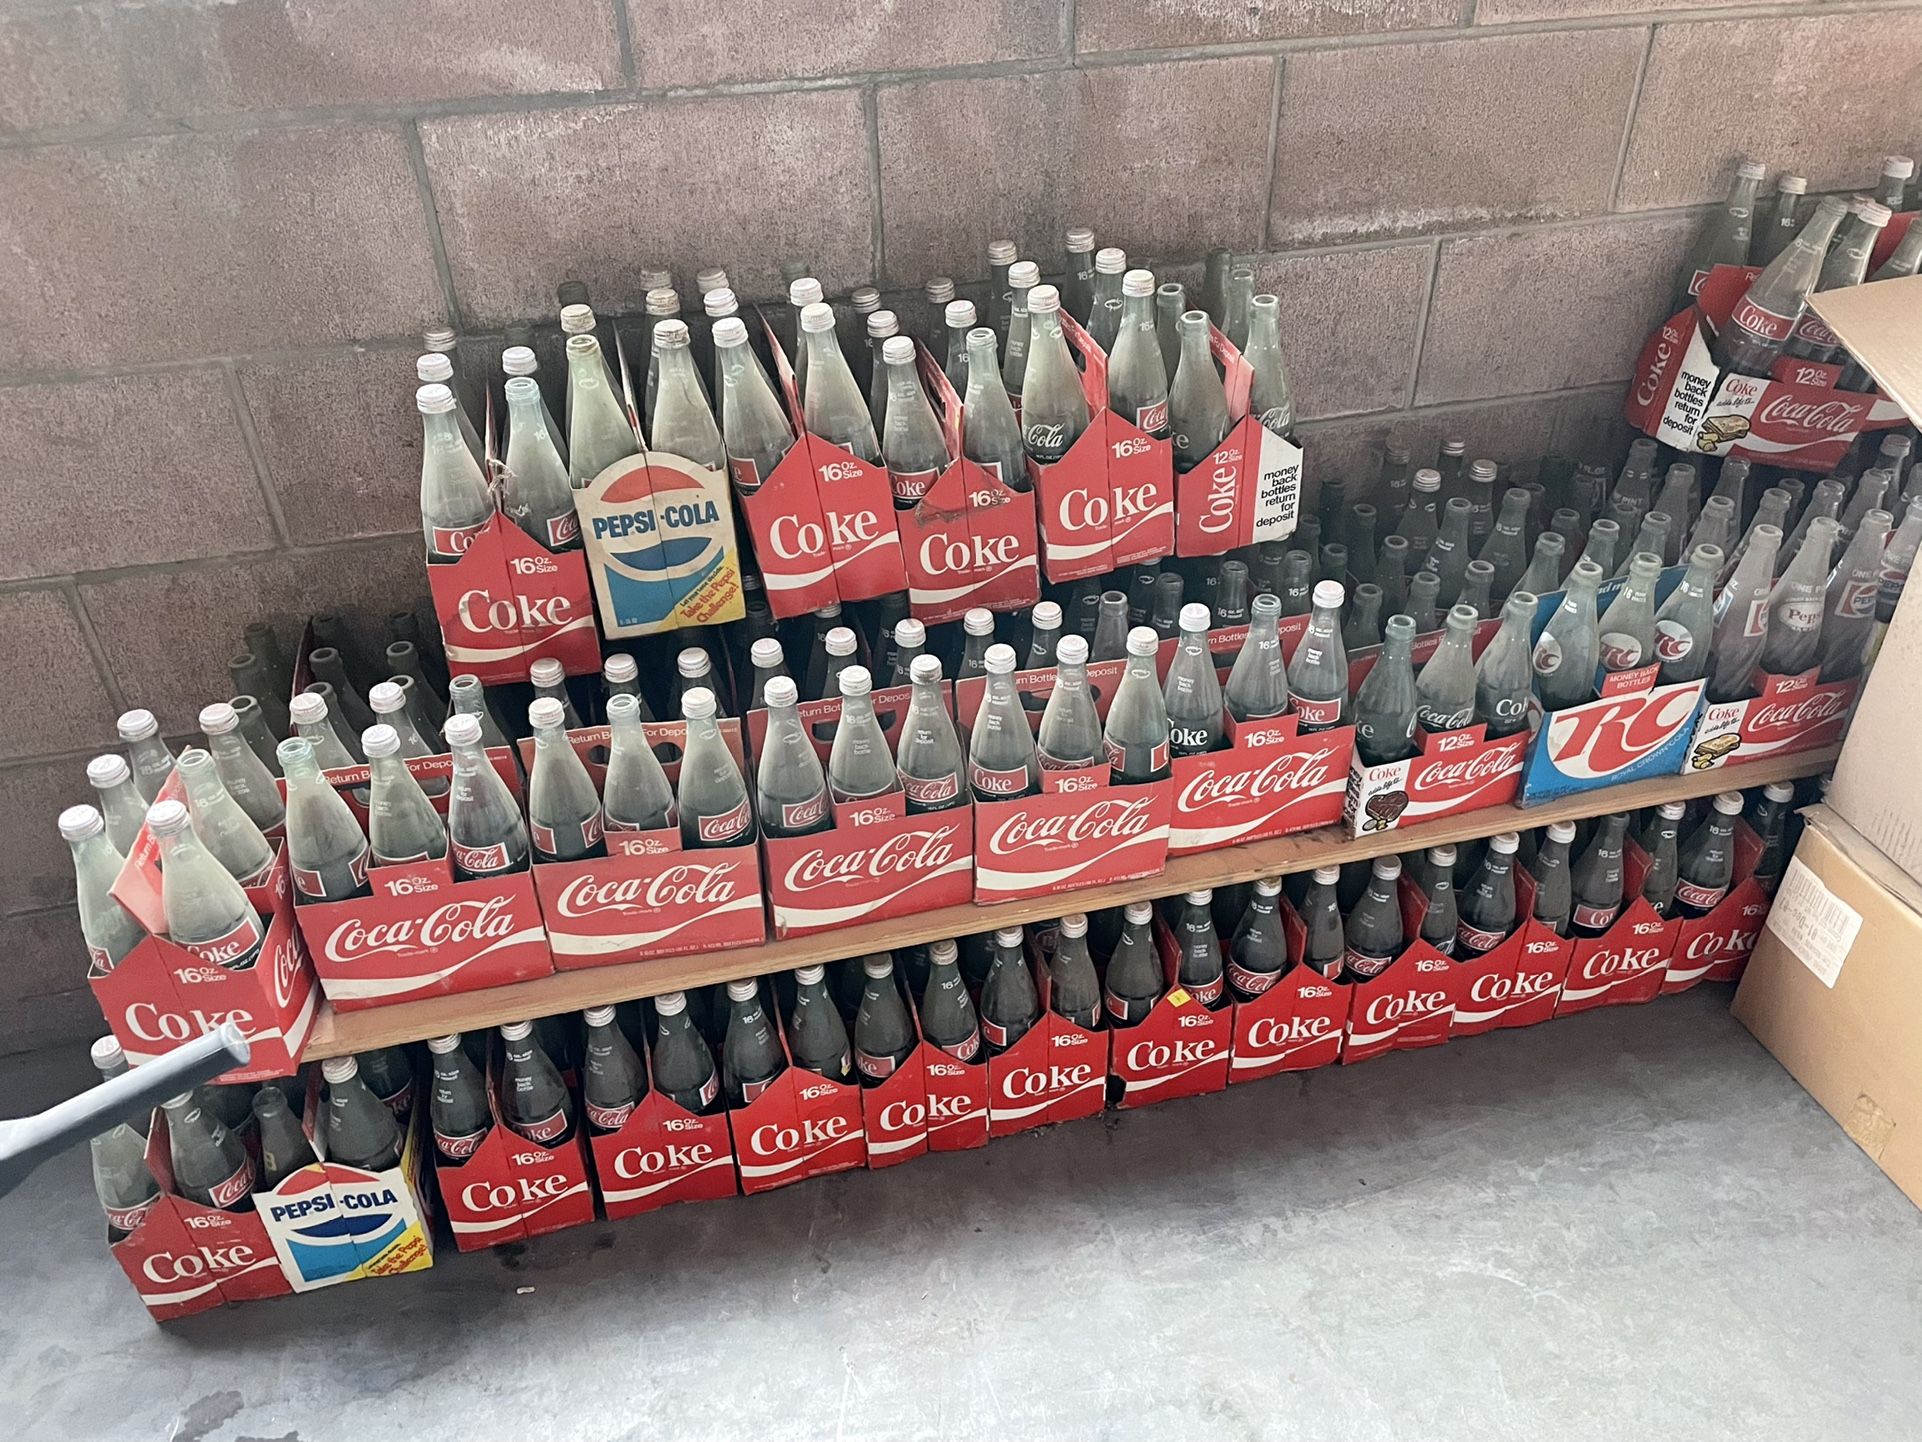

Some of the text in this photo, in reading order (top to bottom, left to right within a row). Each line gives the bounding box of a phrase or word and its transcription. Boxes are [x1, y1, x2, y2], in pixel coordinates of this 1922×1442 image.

[1078, 271, 1088, 280] 16
[1739, 305, 1778, 336] Coke
[1663, 325, 1672, 338] 12
[958, 353, 968, 362] 16
[1637, 341, 1672, 407] Coke
[1681, 371, 1711, 389] money
[1795, 367, 1812, 384] 12
[1684, 382, 1708, 398] back
[1726, 378, 1758, 396] Coke
[1674, 388, 1704, 407] bottles
[1674, 400, 1700, 417] return
[1760, 394, 1863, 432] Coca-Cola
[1662, 416, 1694, 436] deposit
[1684, 414, 1698, 426] for
[1112, 440, 1134, 458] 16
[1133, 438, 1148, 446] Oz.
[1212, 451, 1228, 465] 12
[818, 463, 842, 482] 16
[841, 461, 858, 472] Oz.
[1264, 464, 1299, 481] money
[1272, 473, 1298, 486] back
[968, 490, 992, 507] 16
[1260, 482, 1297, 499] bottles
[1059, 482, 1157, 532] Coke
[1198, 466, 1236, 534] Coke
[1265, 492, 1296, 508] return
[1280, 500, 1294, 512] for
[1256, 510, 1294, 528] deposit
[769, 509, 878, 560] Coke
[919, 532, 1020, 576] Coke
[510, 557, 536, 574] 16
[535, 556, 552, 566] Oz.
[680, 566, 736, 618] Take the Pepsi
[1289, 588, 1300, 597] 16
[1623, 586, 1633, 600] 16
[697, 582, 739, 622] Challenge!
[458, 590, 572, 634] Coke
[1259, 640, 1270, 650] 16
[1610, 666, 1658, 683] MONEY BACK
[1616, 676, 1652, 689] BOTTLES
[1776, 680, 1791, 694] 12
[1708, 708, 1740, 720] Coke
[1748, 688, 1847, 732] Coca-Cola
[568, 732, 600, 744] Return
[660, 726, 688, 738] Depo
[1552, 684, 1700, 773] RC
[1244, 732, 1266, 748] 16
[1266, 729, 1281, 738] Oz.
[1438, 737, 1456, 752] 12
[1457, 733, 1472, 742] Oz.
[1611, 727, 1690, 782] ROYAL CROWN COLA
[423, 760, 452, 772] Depo
[1369, 767, 1402, 782] Coke
[1414, 741, 1523, 791] Coca-Cola
[974, 770, 1012, 792] Coke
[1055, 778, 1078, 793] 16
[1078, 776, 1094, 785] Oz.
[1177, 746, 1341, 812] Coca-Cola
[850, 811, 874, 827] 16
[874, 808, 890, 816] Oz.
[988, 794, 1159, 854] Coca-Cola
[619, 840, 646, 856] 16
[646, 839, 662, 848] Oz.
[784, 822, 960, 892] Coca-Cola
[384, 880, 412, 896] 16
[412, 876, 432, 886] Oz.
[556, 860, 742, 918] Coca-Cola
[324, 892, 517, 964] Coca-Cola
[1633, 923, 1650, 935] 16
[1526, 941, 1544, 954] 16
[1416, 960, 1434, 972] 16
[1582, 946, 1660, 980] Coke
[174, 968, 200, 984] 16
[200, 966, 218, 976] Oz.
[1298, 986, 1316, 1000] 16
[1470, 971, 1553, 1002] Coke
[1366, 990, 1446, 1025] Coke
[125, 1002, 257, 1042] Coke
[1178, 1016, 1198, 1028] 16
[1248, 1014, 1332, 1048] Coke
[1052, 1034, 1070, 1047] 16
[1127, 1038, 1216, 1072] Coke
[926, 1064, 947, 1076] 16
[1002, 1062, 1092, 1098] Coke
[800, 1086, 820, 1101] 16
[879, 1094, 972, 1132] Coke
[662, 1120, 684, 1132] 16
[750, 1114, 848, 1157] Coke
[512, 1154, 534, 1166] 16
[614, 1142, 714, 1180] Coke
[461, 1174, 568, 1213] Coke
[184, 1217, 208, 1230] 16
[142, 1244, 257, 1286] Coke
